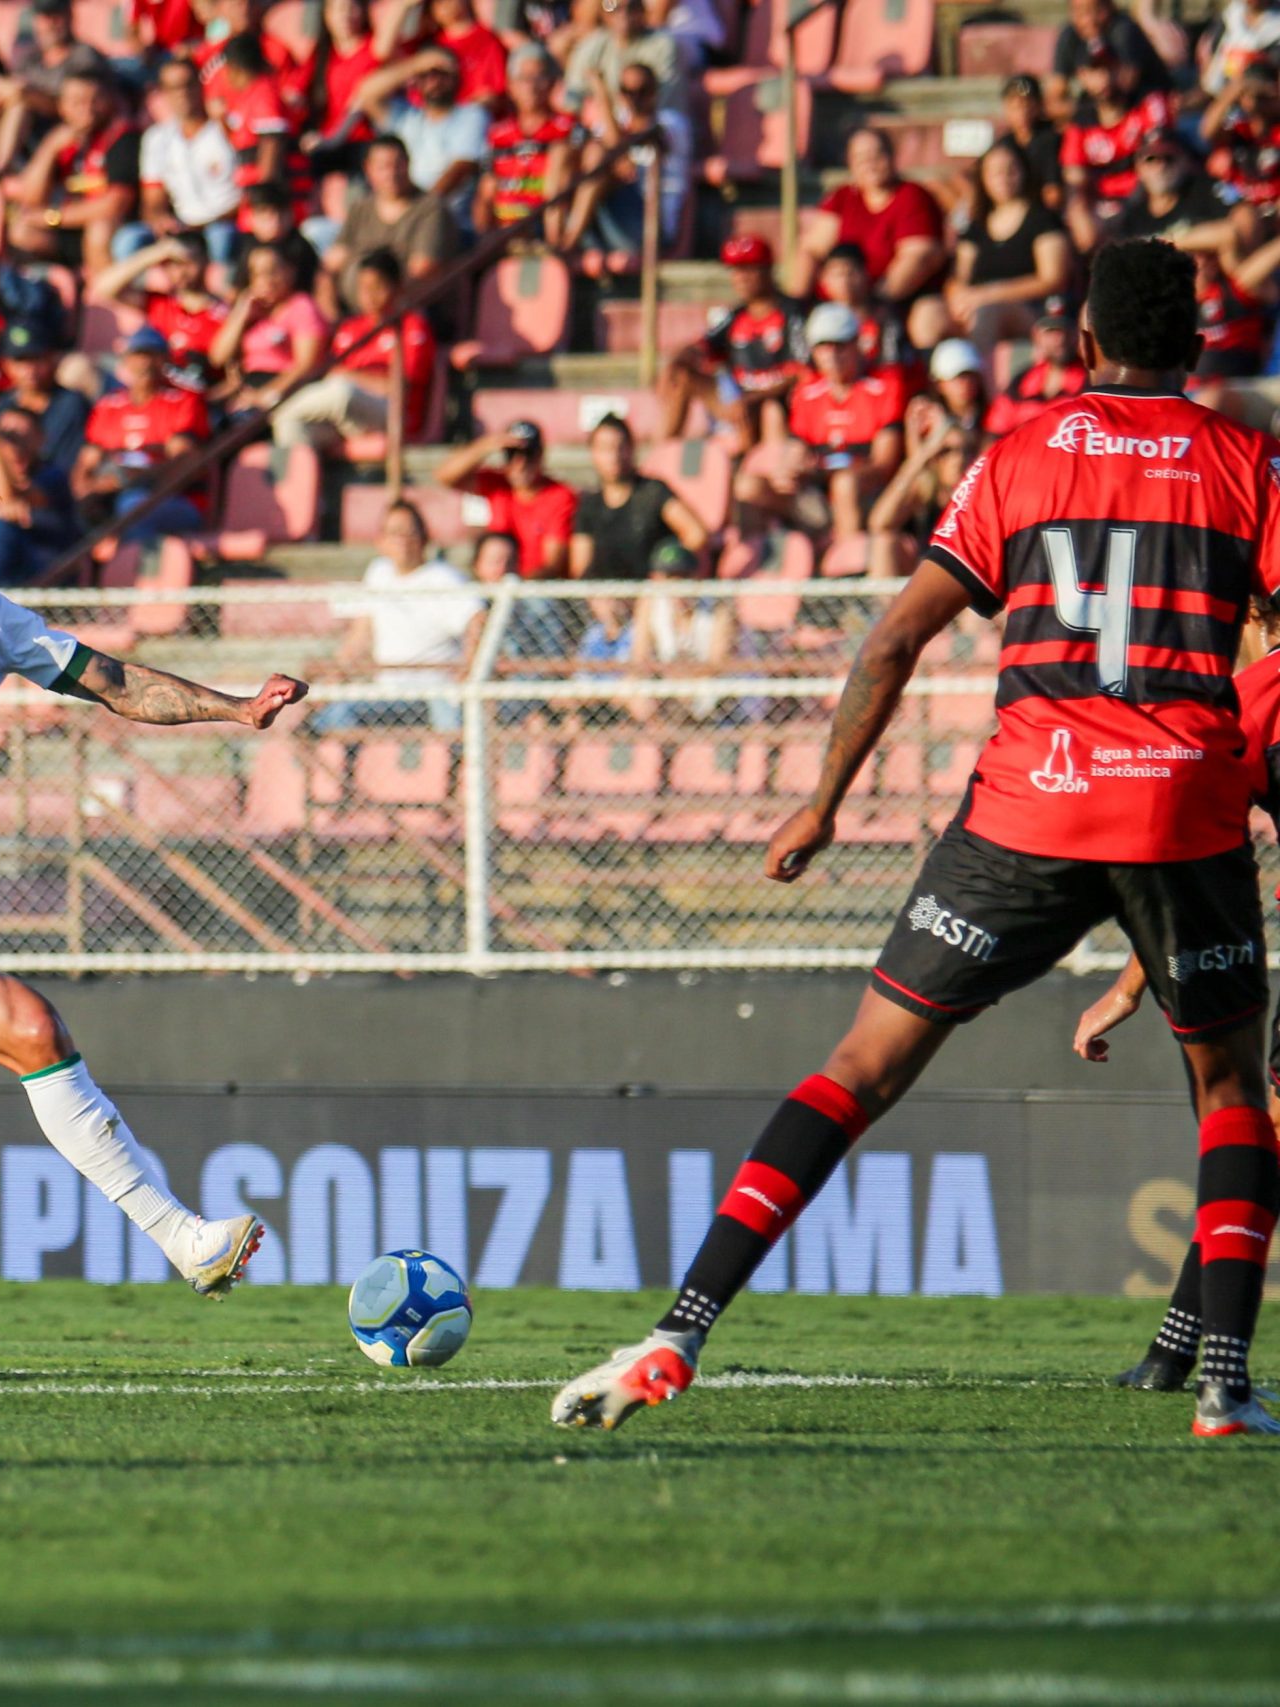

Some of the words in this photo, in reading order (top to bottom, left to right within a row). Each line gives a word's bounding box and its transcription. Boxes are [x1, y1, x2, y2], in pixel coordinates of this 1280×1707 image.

[1084, 432, 1191, 459] Euro17
[1143, 467, 1200, 483] CRÉDITO
[1041, 527, 1137, 697] 4
[1091, 746, 1132, 763] água
[1136, 744, 1204, 760] alcalina
[1090, 764, 1171, 778] isotônica
[200, 1142, 641, 1291] SOUZA
